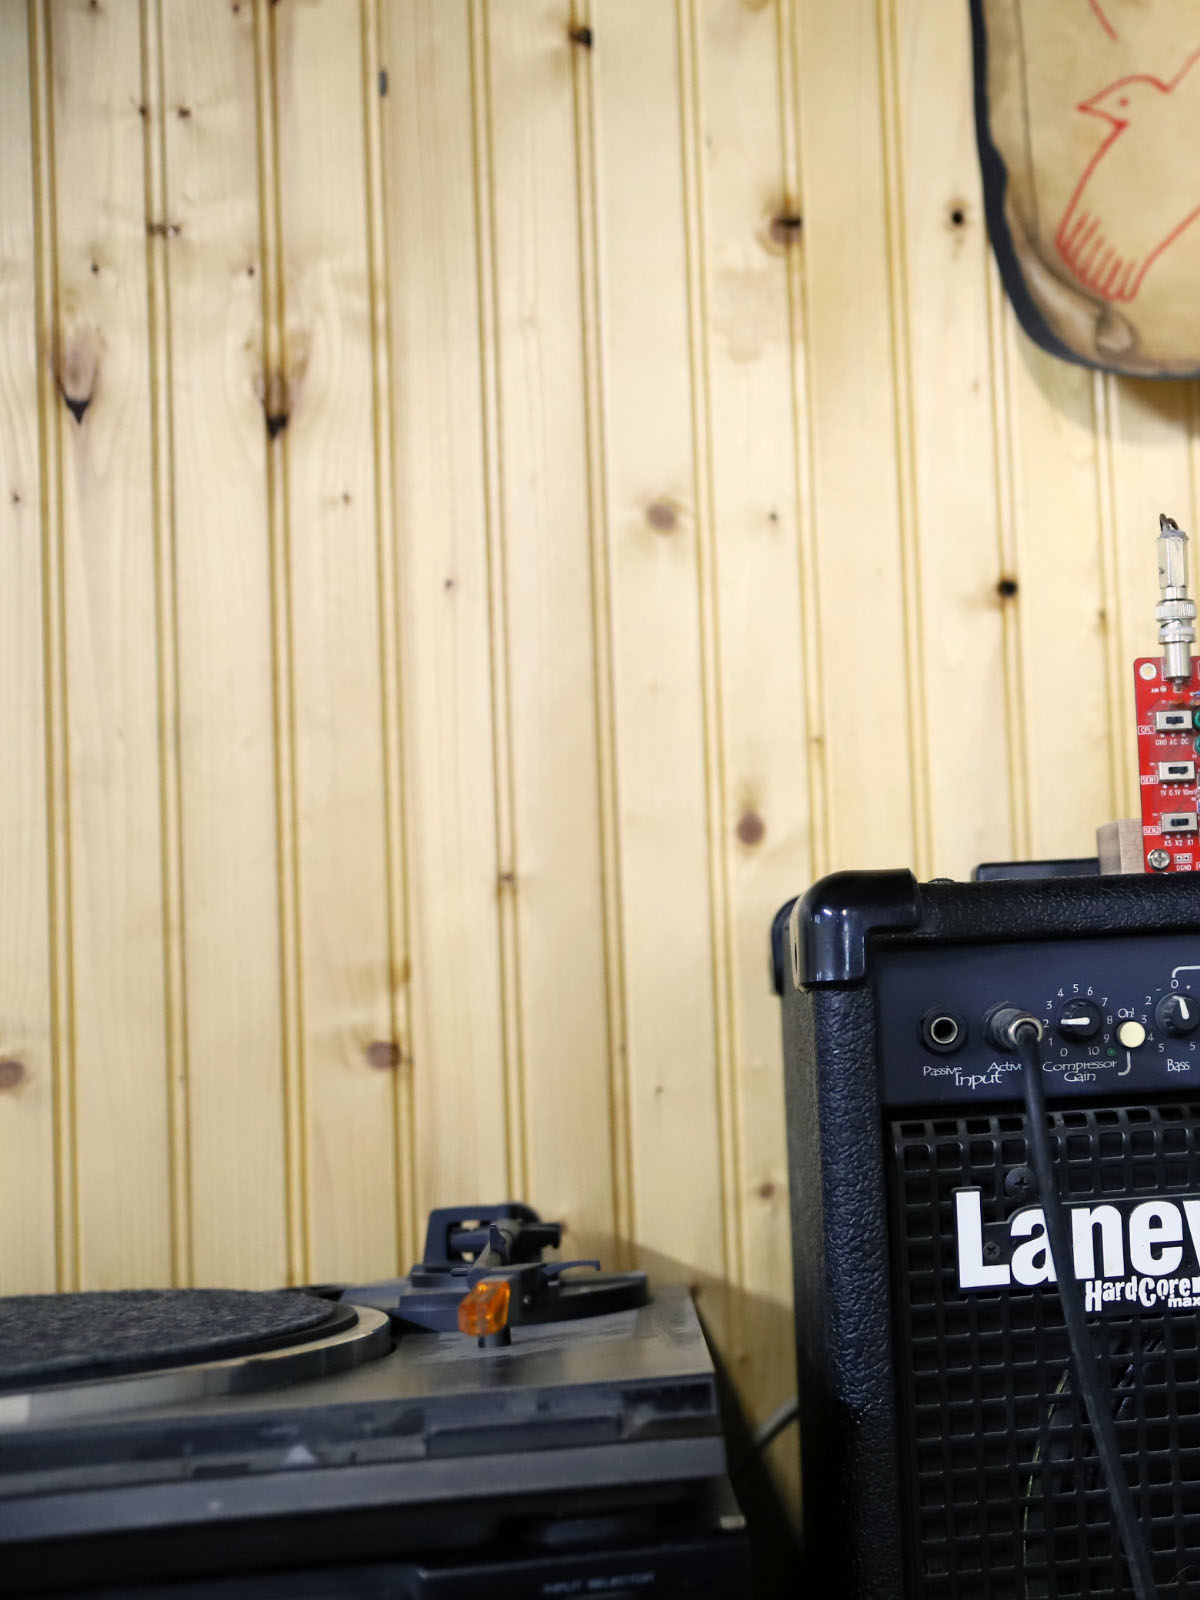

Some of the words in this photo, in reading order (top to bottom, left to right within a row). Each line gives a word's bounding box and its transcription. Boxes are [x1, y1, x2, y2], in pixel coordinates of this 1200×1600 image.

[1058, 988, 1064, 997] 4
[1073, 984, 1078, 992] 5
[1087, 986, 1093, 996] 6
[1046, 1000, 1052, 1009] 3
[1102, 997, 1108, 1006] 7
[1145, 996, 1152, 1005] 2
[1118, 1007, 1134, 1019] On!
[1043, 1019, 1048, 1028] 2
[1107, 1016, 1113, 1024] 8
[1142, 1015, 1147, 1023] 3
[1104, 1034, 1110, 1043] 9
[1148, 1033, 1154, 1041] 4
[1088, 1046, 1100, 1055] 10
[1159, 1043, 1164, 1052] 5
[1190, 1042, 1196, 1050] 5
[1060, 1048, 1068, 1056] 0
[1042, 1060, 1117, 1073] Compressor
[1167, 1059, 1190, 1072] Bass
[923, 1066, 962, 1077] Passive
[955, 1072, 1003, 1089] Input
[1064, 1072, 1096, 1082] Gain
[1084, 1276, 1191, 1312] HardCore
[1167, 1296, 1200, 1308] max
